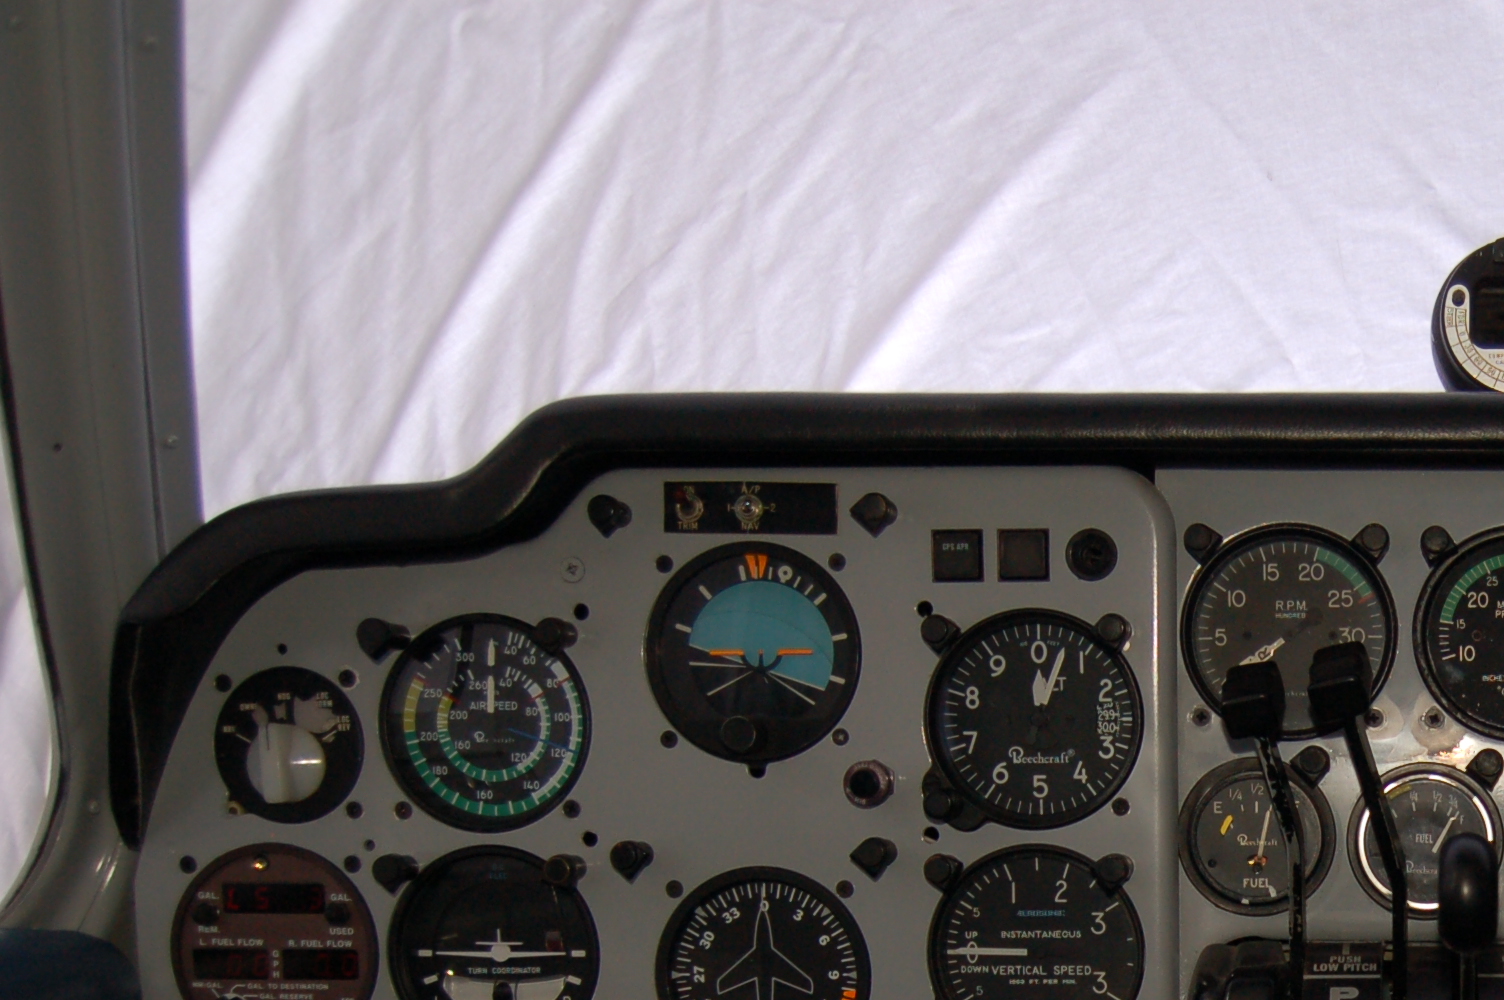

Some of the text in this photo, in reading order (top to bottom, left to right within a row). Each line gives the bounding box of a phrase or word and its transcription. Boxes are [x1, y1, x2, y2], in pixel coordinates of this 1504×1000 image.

[677, 522, 699, 531] TRIM
[1263, 563, 1279, 581] 15
[1299, 564, 1324, 581] 20
[1486, 577, 1498, 586] 25
[1227, 590, 1246, 608] 10
[1328, 590, 1353, 608] 25
[1467, 592, 1489, 608] 20
[1456, 619, 1466, 629] 15
[1214, 629, 1227, 646] 5
[1030, 640, 1047, 664] 0
[1459, 646, 1476, 662] 10
[455, 653, 475, 662] 300
[523, 656, 536, 665] 60
[989, 655, 1006, 678] 9
[469, 681, 487, 690] 260
[424, 689, 442, 698] 250
[1099, 679, 1113, 703] 2
[965, 686, 980, 710] 8
[450, 711, 468, 720] 200
[554, 713, 570, 722] 100
[420, 731, 439, 741] 200
[454, 741, 471, 750] 160
[963, 731, 978, 754] 7
[1099, 736, 1115, 760] 3
[511, 753, 527, 762] 120
[551, 749, 567, 758] 120
[432, 766, 448, 775] 180
[992, 762, 1009, 784] 6
[1073, 761, 1087, 784] 4
[523, 781, 540, 790] 140
[1033, 775, 1049, 798] 5
[1251, 783, 1264, 795] 1/2
[476, 790, 493, 799] 160
[1415, 834, 1433, 844] FUEL
[1243, 878, 1270, 888] FUEL
[1054, 880, 1067, 903] 2
[1090, 912, 1106, 935] 3
[329, 927, 354, 935] USED
[965, 931, 978, 939] UP
[1001, 930, 1081, 939] INSTANTANEOUS
[1330, 955, 1361, 963] PUSH
[961, 965, 989, 973] DOWN
[991, 965, 1092, 976] VERTICAL SPEED
[1313, 963, 1377, 972] LOW PITCH
[1092, 972, 1107, 994] 3
